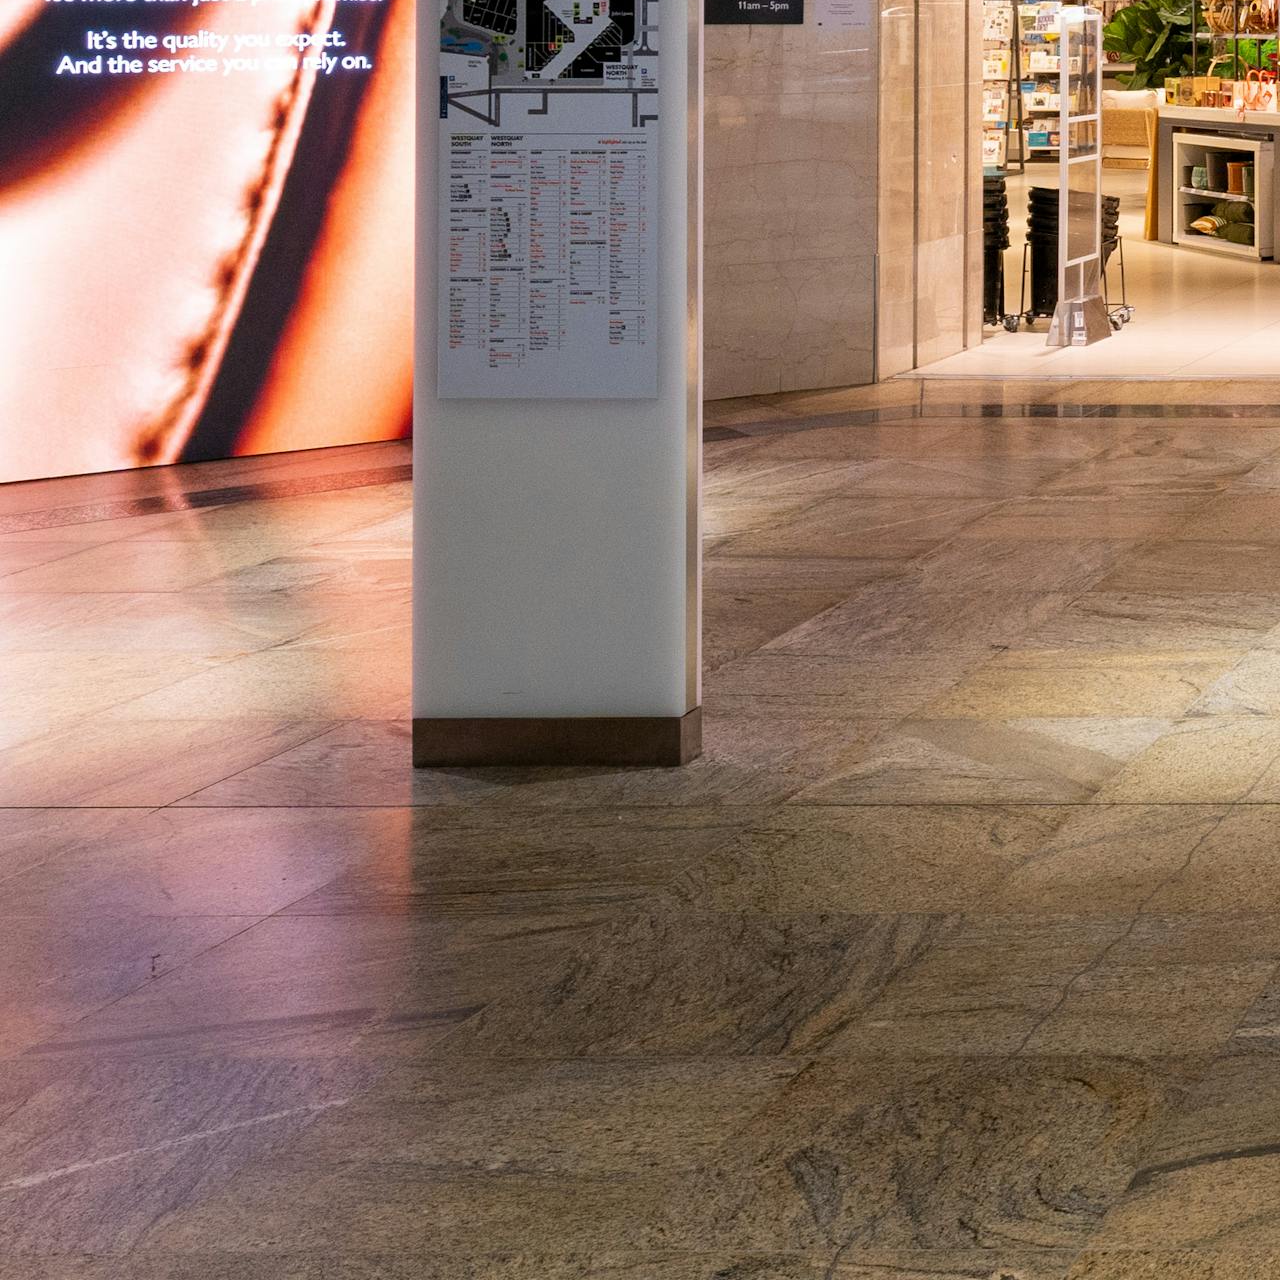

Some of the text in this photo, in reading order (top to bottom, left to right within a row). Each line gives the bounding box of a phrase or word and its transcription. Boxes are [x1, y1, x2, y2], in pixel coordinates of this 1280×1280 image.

[738, 1, 761, 10] 11am
[769, 1, 789, 12] 5pm
[87, 30, 346, 53] It's the quality you expect.
[56, 55, 101, 74] And
[107, 55, 143, 74] the
[147, 54, 218, 73] service
[223, 58, 262, 77] you
[302, 52, 337, 75] rely
[341, 55, 372, 70] on.
